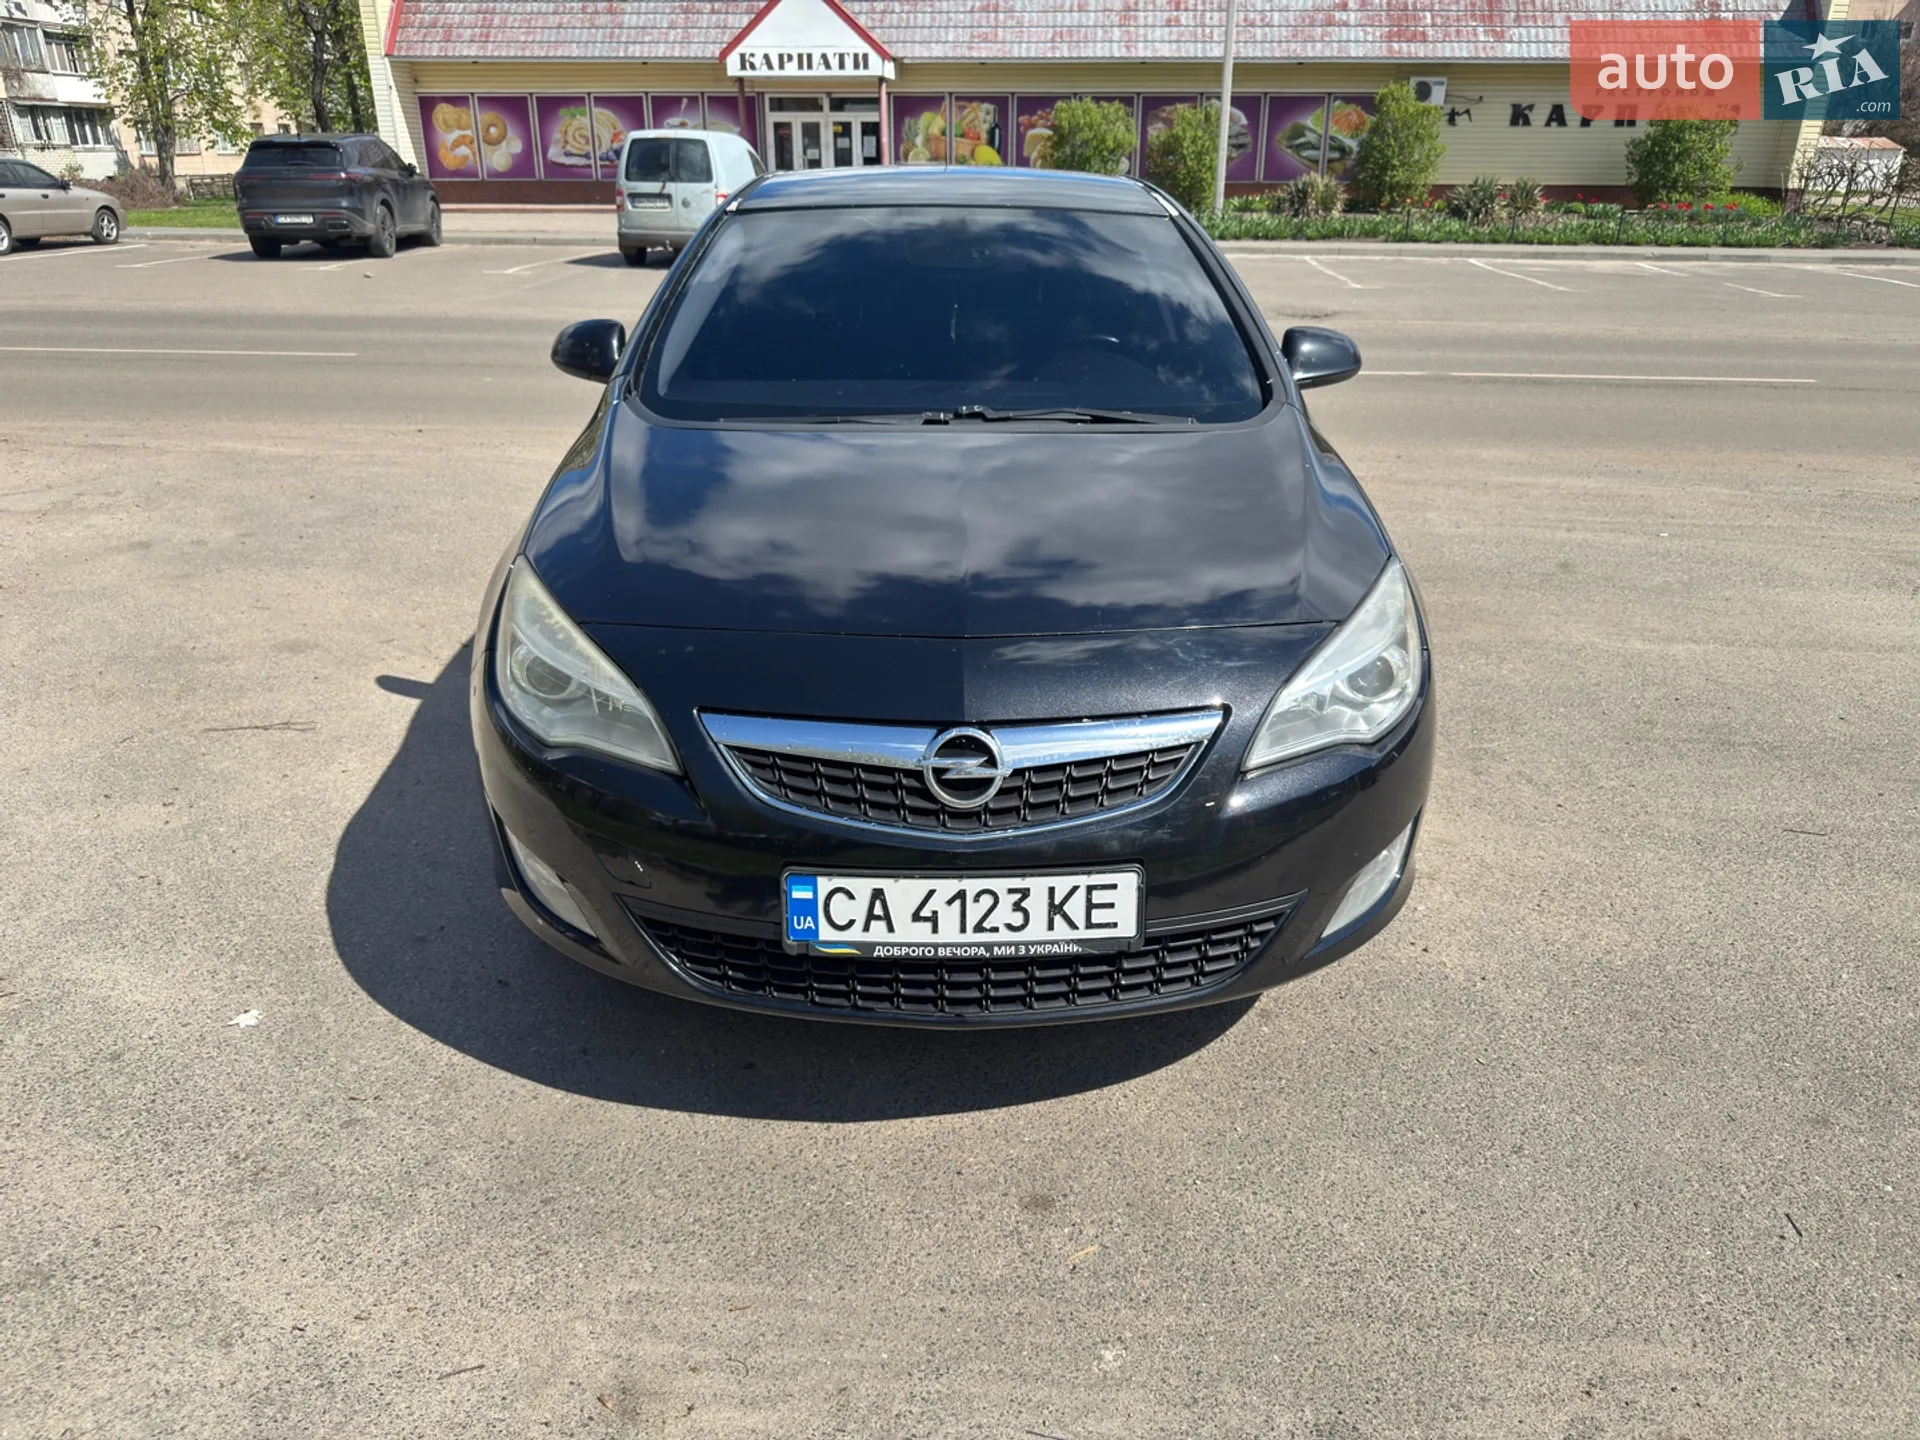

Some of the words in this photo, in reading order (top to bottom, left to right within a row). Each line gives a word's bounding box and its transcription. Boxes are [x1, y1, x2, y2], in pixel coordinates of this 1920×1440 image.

[738, 51, 870, 72] КАРПАТИ
[823, 886, 896, 934] CA
[911, 886, 1031, 935] 4123
[1047, 883, 1119, 931] KE
[793, 916, 815, 930] UA
[873, 945, 935, 958] ДОБРОГО
[938, 945, 990, 958] ВЕЧОРА,
[993, 945, 1016, 955] МИ
